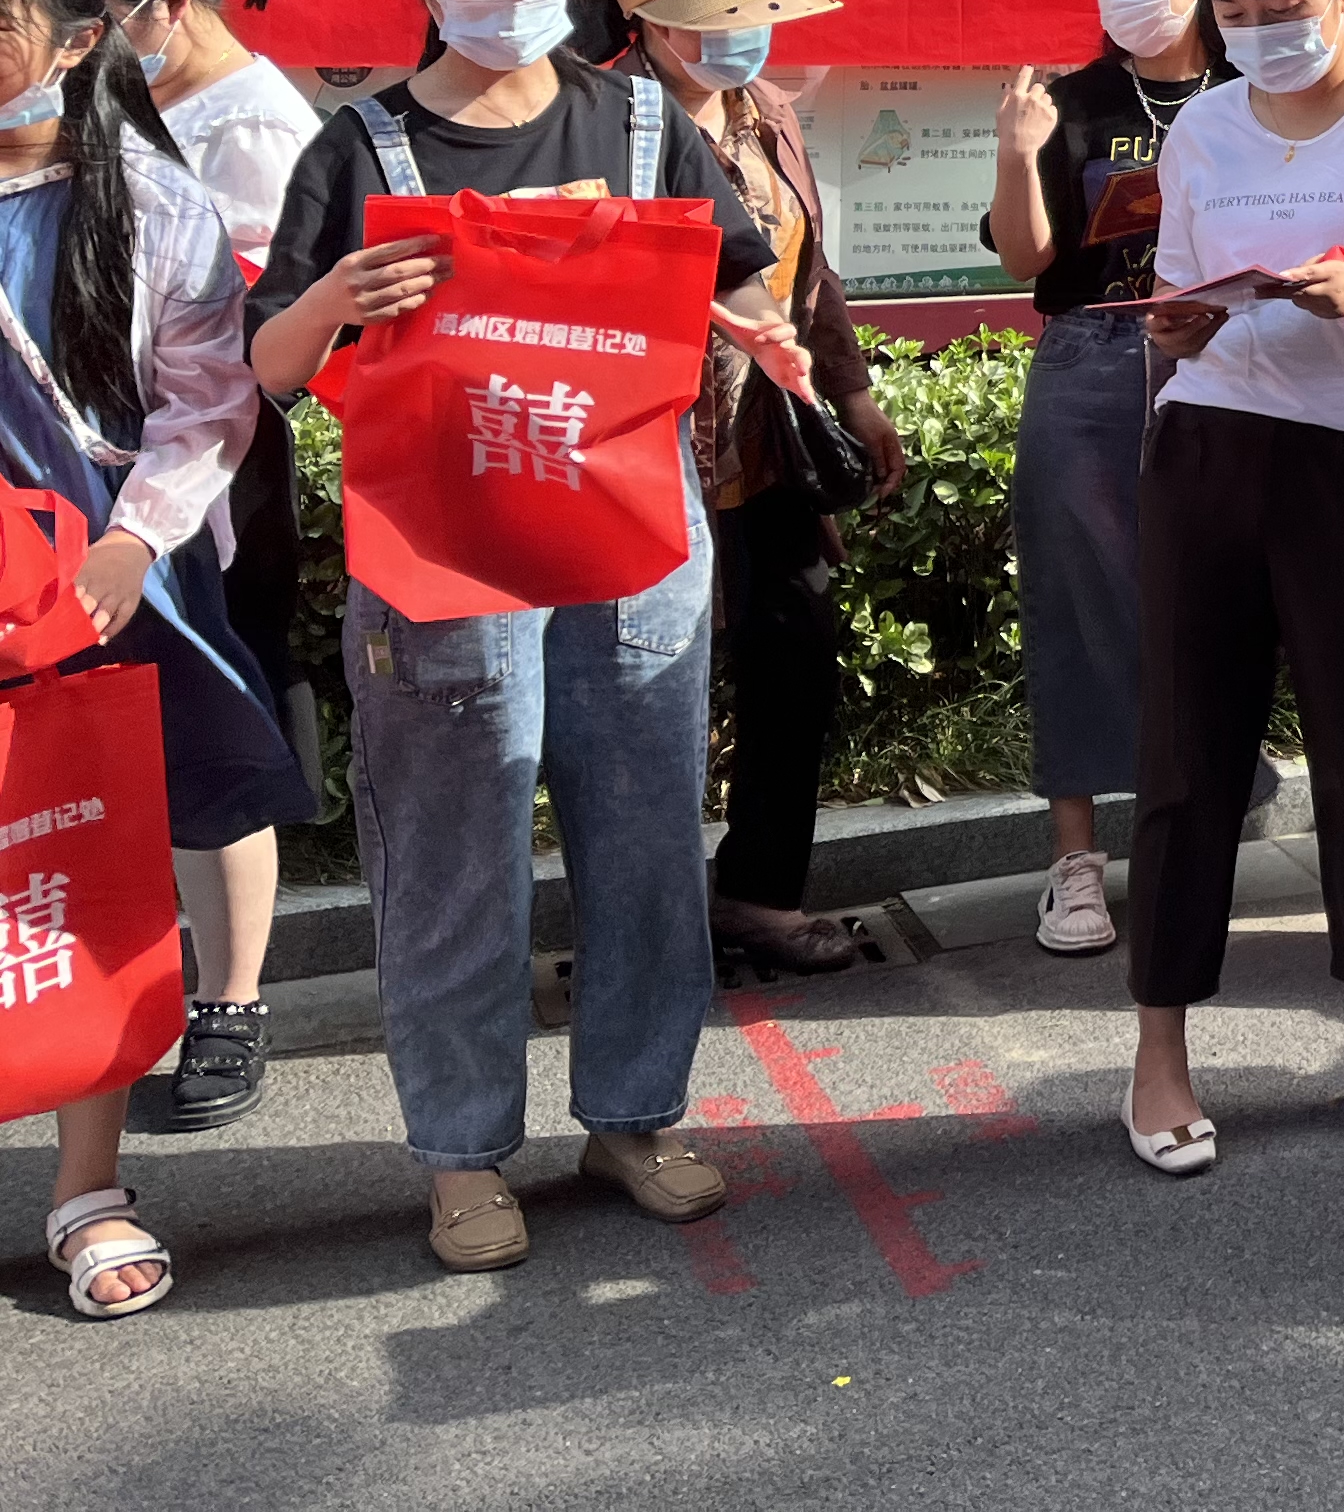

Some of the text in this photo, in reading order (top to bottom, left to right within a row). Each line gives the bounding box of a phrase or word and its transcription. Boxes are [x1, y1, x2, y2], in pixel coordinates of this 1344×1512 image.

[1204, 193, 1285, 212] EVERYTHING
[1288, 192, 1315, 204] HAS
[1269, 209, 1295, 220] 1980
[432, 312, 647, 357] 海州区婚姻登记处
